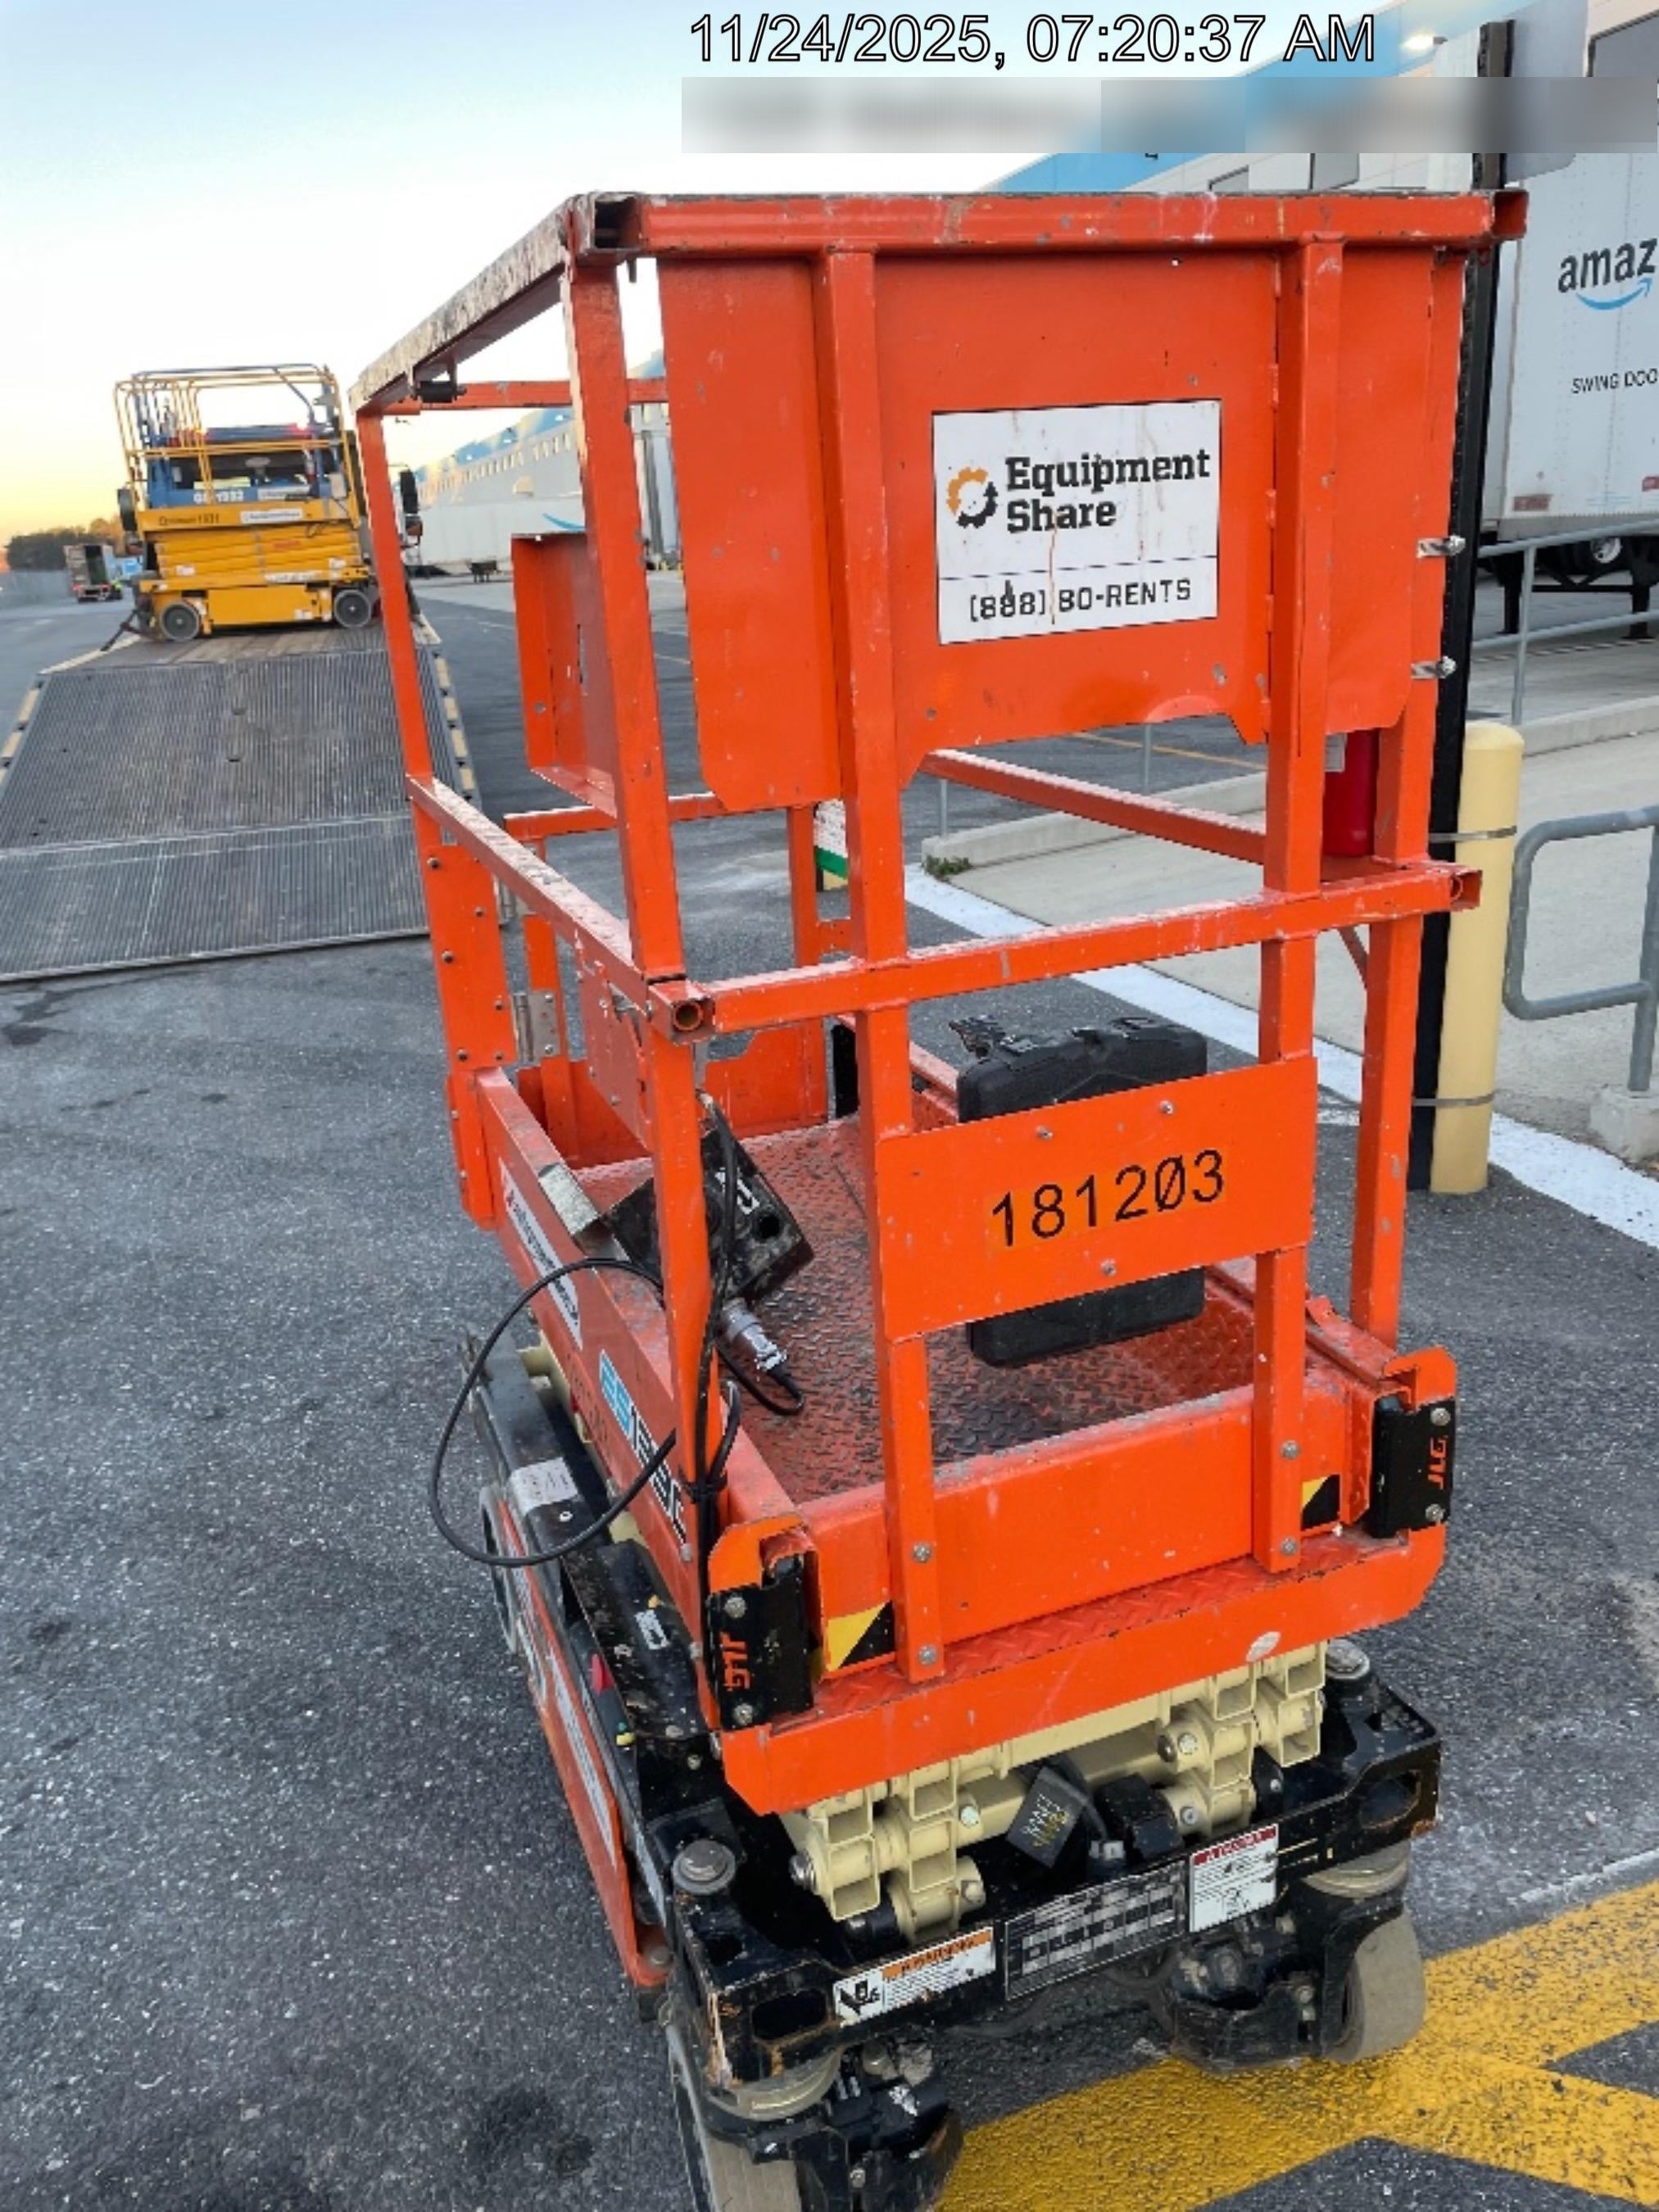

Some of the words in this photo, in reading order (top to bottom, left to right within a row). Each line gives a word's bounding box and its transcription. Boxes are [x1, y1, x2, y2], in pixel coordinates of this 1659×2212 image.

[1571, 373, 1619, 394] SWING
[1005, 449, 1210, 496] Equipment
[1007, 498, 1117, 534] Share
[992, 1149, 1224, 1247] 181203
[1428, 1435, 1448, 1490] JLG
[720, 1631, 751, 1692] JLG
